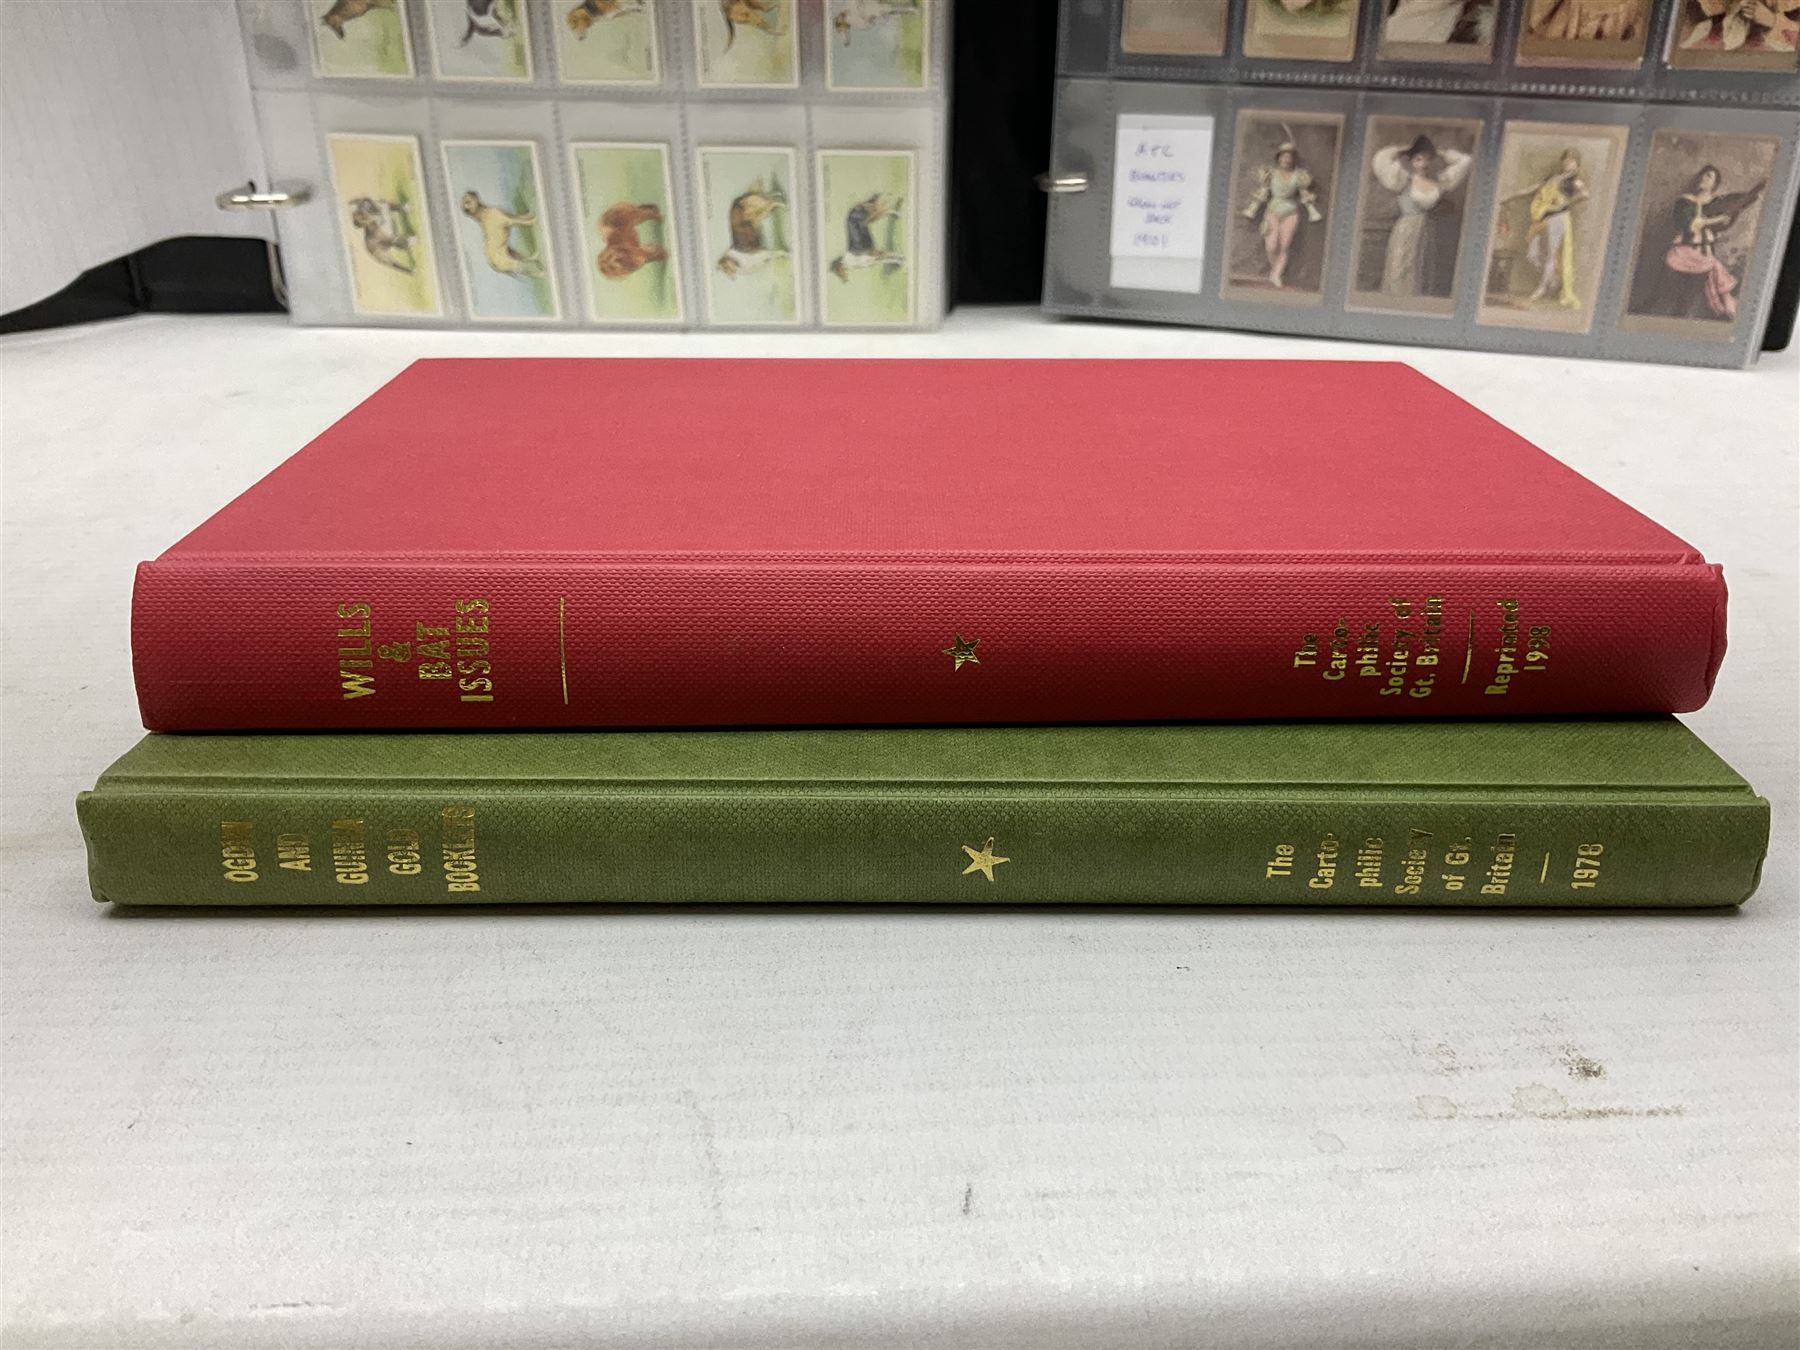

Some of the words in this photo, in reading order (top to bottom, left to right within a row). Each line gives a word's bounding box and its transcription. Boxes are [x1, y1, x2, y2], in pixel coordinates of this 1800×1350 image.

[1388, 595, 1412, 619] of
[1415, 595, 1442, 666] Britain
[336, 603, 376, 700] WILLS
[377, 641, 412, 662] &
[416, 620, 452, 680] BAT
[455, 598, 494, 702] ISSUES
[1293, 633, 1318, 668] The
[1355, 623, 1382, 677] philic
[1379, 628, 1416, 695] Society
[1484, 599, 1520, 695] Reprinted
[1523, 625, 1551, 670] 1998
[1408, 673, 1438, 698] Gt.
[221, 820, 259, 882] OGDN
[277, 833, 312, 871] AND
[331, 819, 369, 885] GUINA
[386, 829, 422, 875] GOLD
[1266, 843, 1294, 879] The
[1355, 837, 1383, 888] philic
[1480, 832, 1516, 895] Britain
[1571, 843, 1604, 889] 1978
[1441, 872, 1465, 891] of
